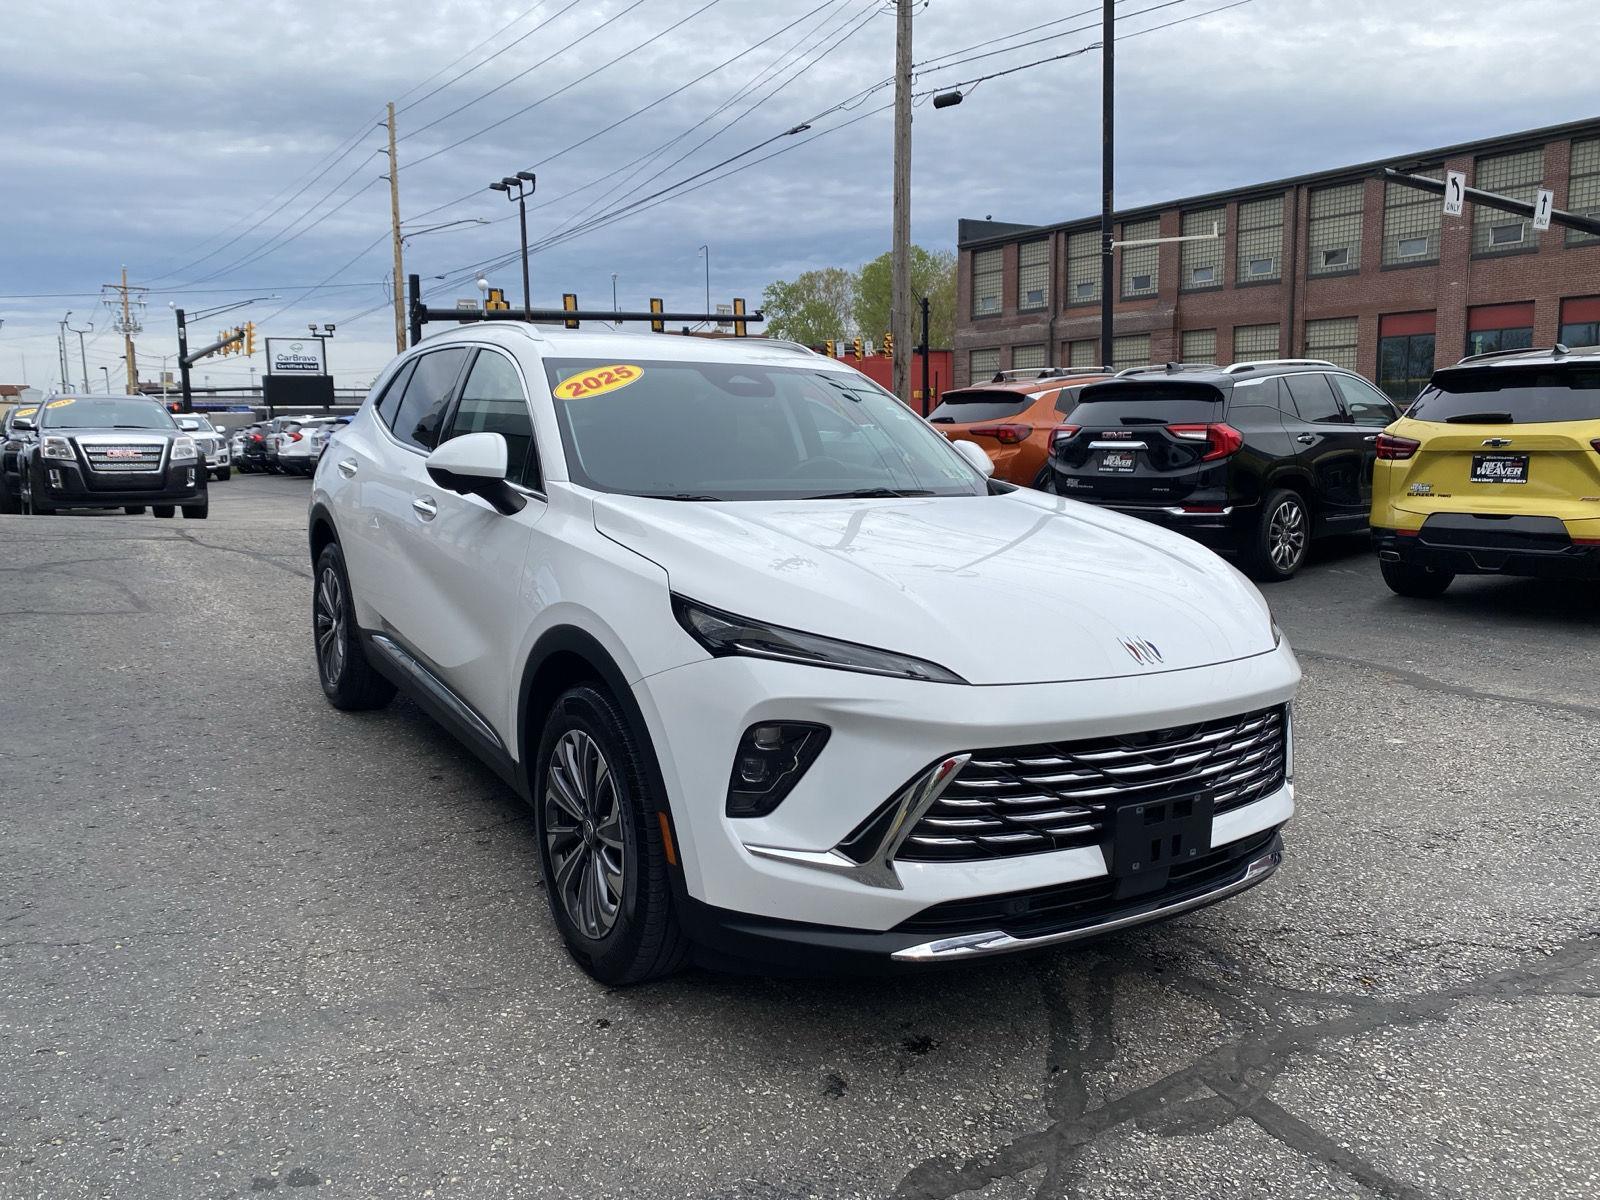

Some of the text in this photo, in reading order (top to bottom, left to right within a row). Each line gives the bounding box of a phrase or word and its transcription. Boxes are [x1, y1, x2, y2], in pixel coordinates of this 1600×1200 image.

[1446, 202, 1461, 212] ONLY
[277, 354, 317, 362] CarBravo
[566, 366, 634, 397] 2025
[1476, 467, 1523, 475] WEAVER
